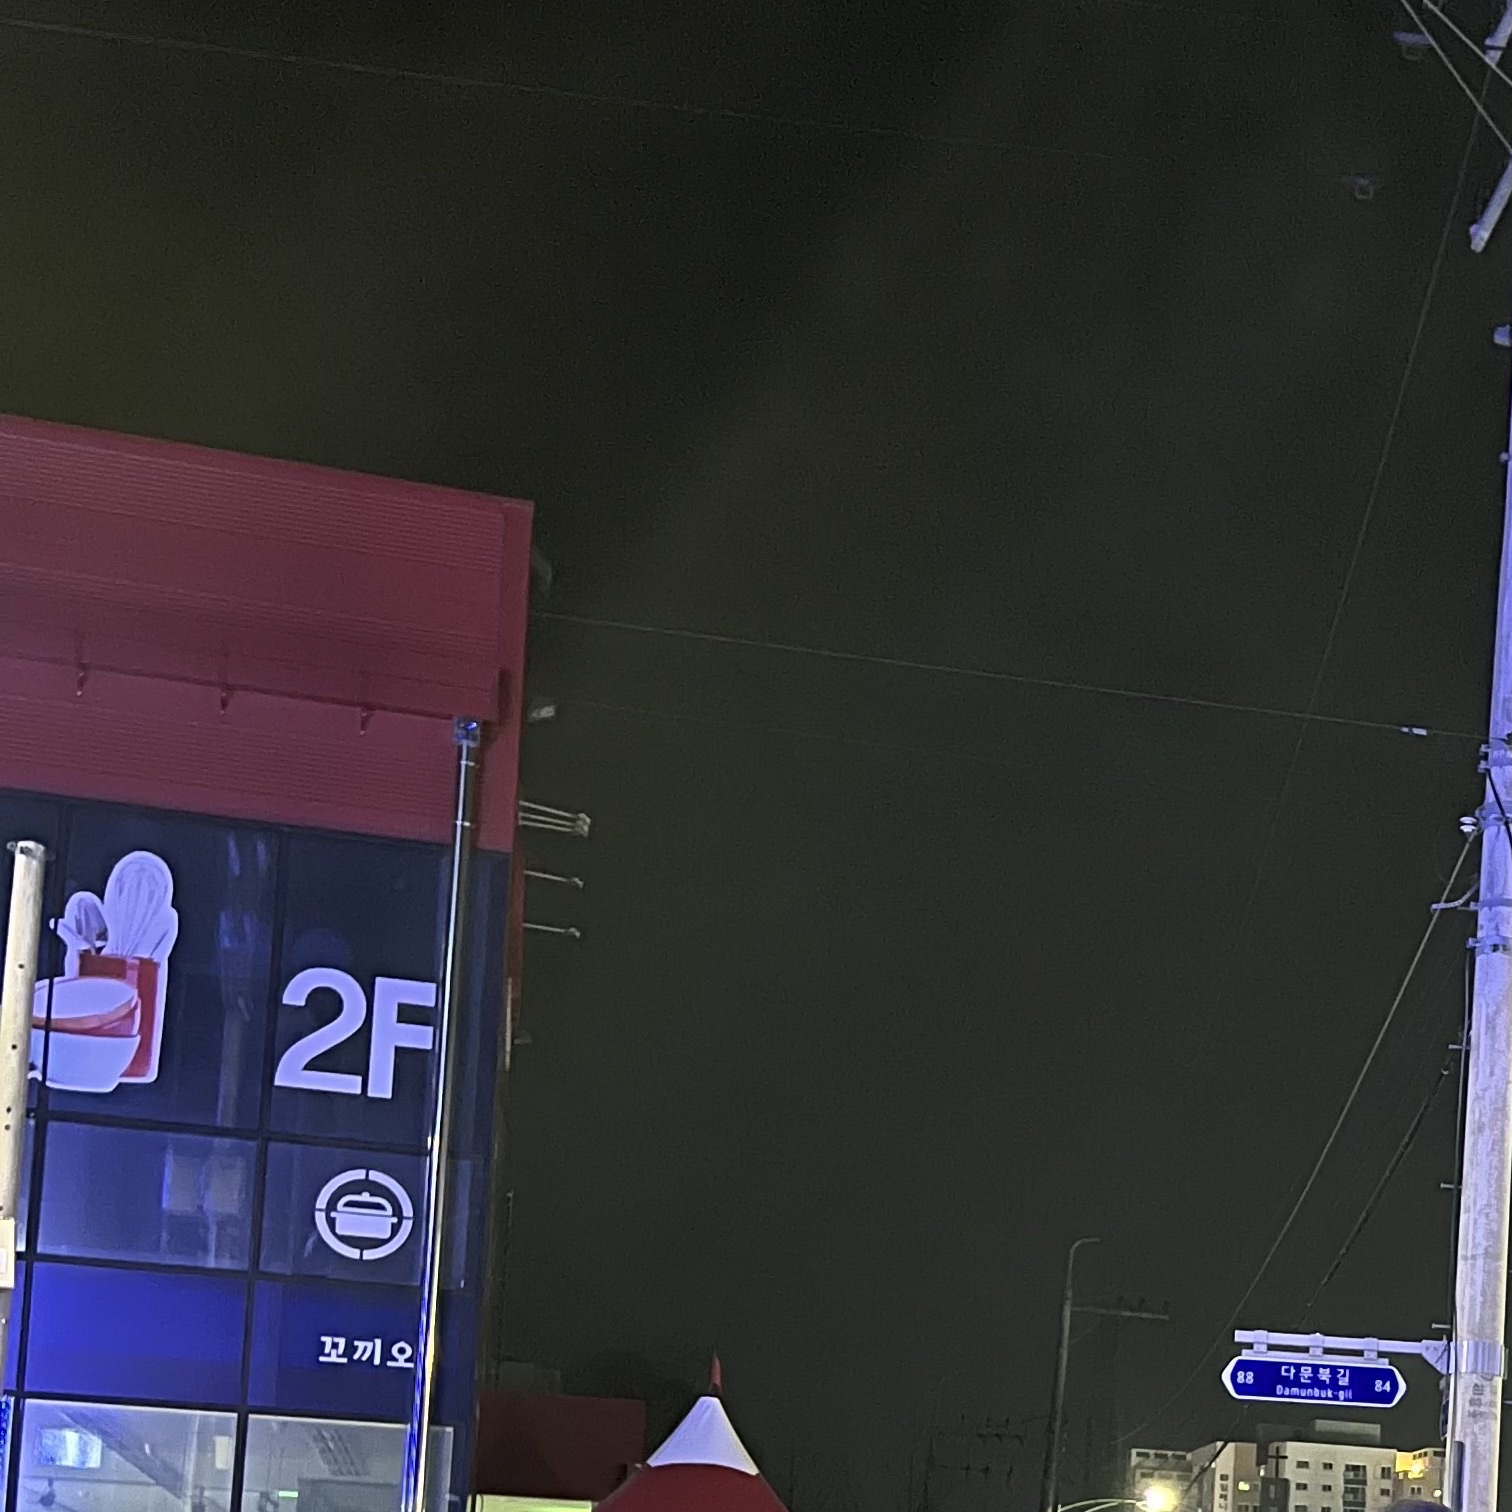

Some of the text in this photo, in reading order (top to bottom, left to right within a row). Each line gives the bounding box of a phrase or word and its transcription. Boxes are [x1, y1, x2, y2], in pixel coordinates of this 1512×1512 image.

[274, 967, 437, 1099] 2F
[318, 1335, 415, 1368] 꼬끼오
[1236, 1371, 1254, 1384] 88
[1281, 1365, 1351, 1386] 다문북길
[1276, 1385, 1353, 1401] Damunbuk-gil
[1374, 1380, 1391, 1393] 84
